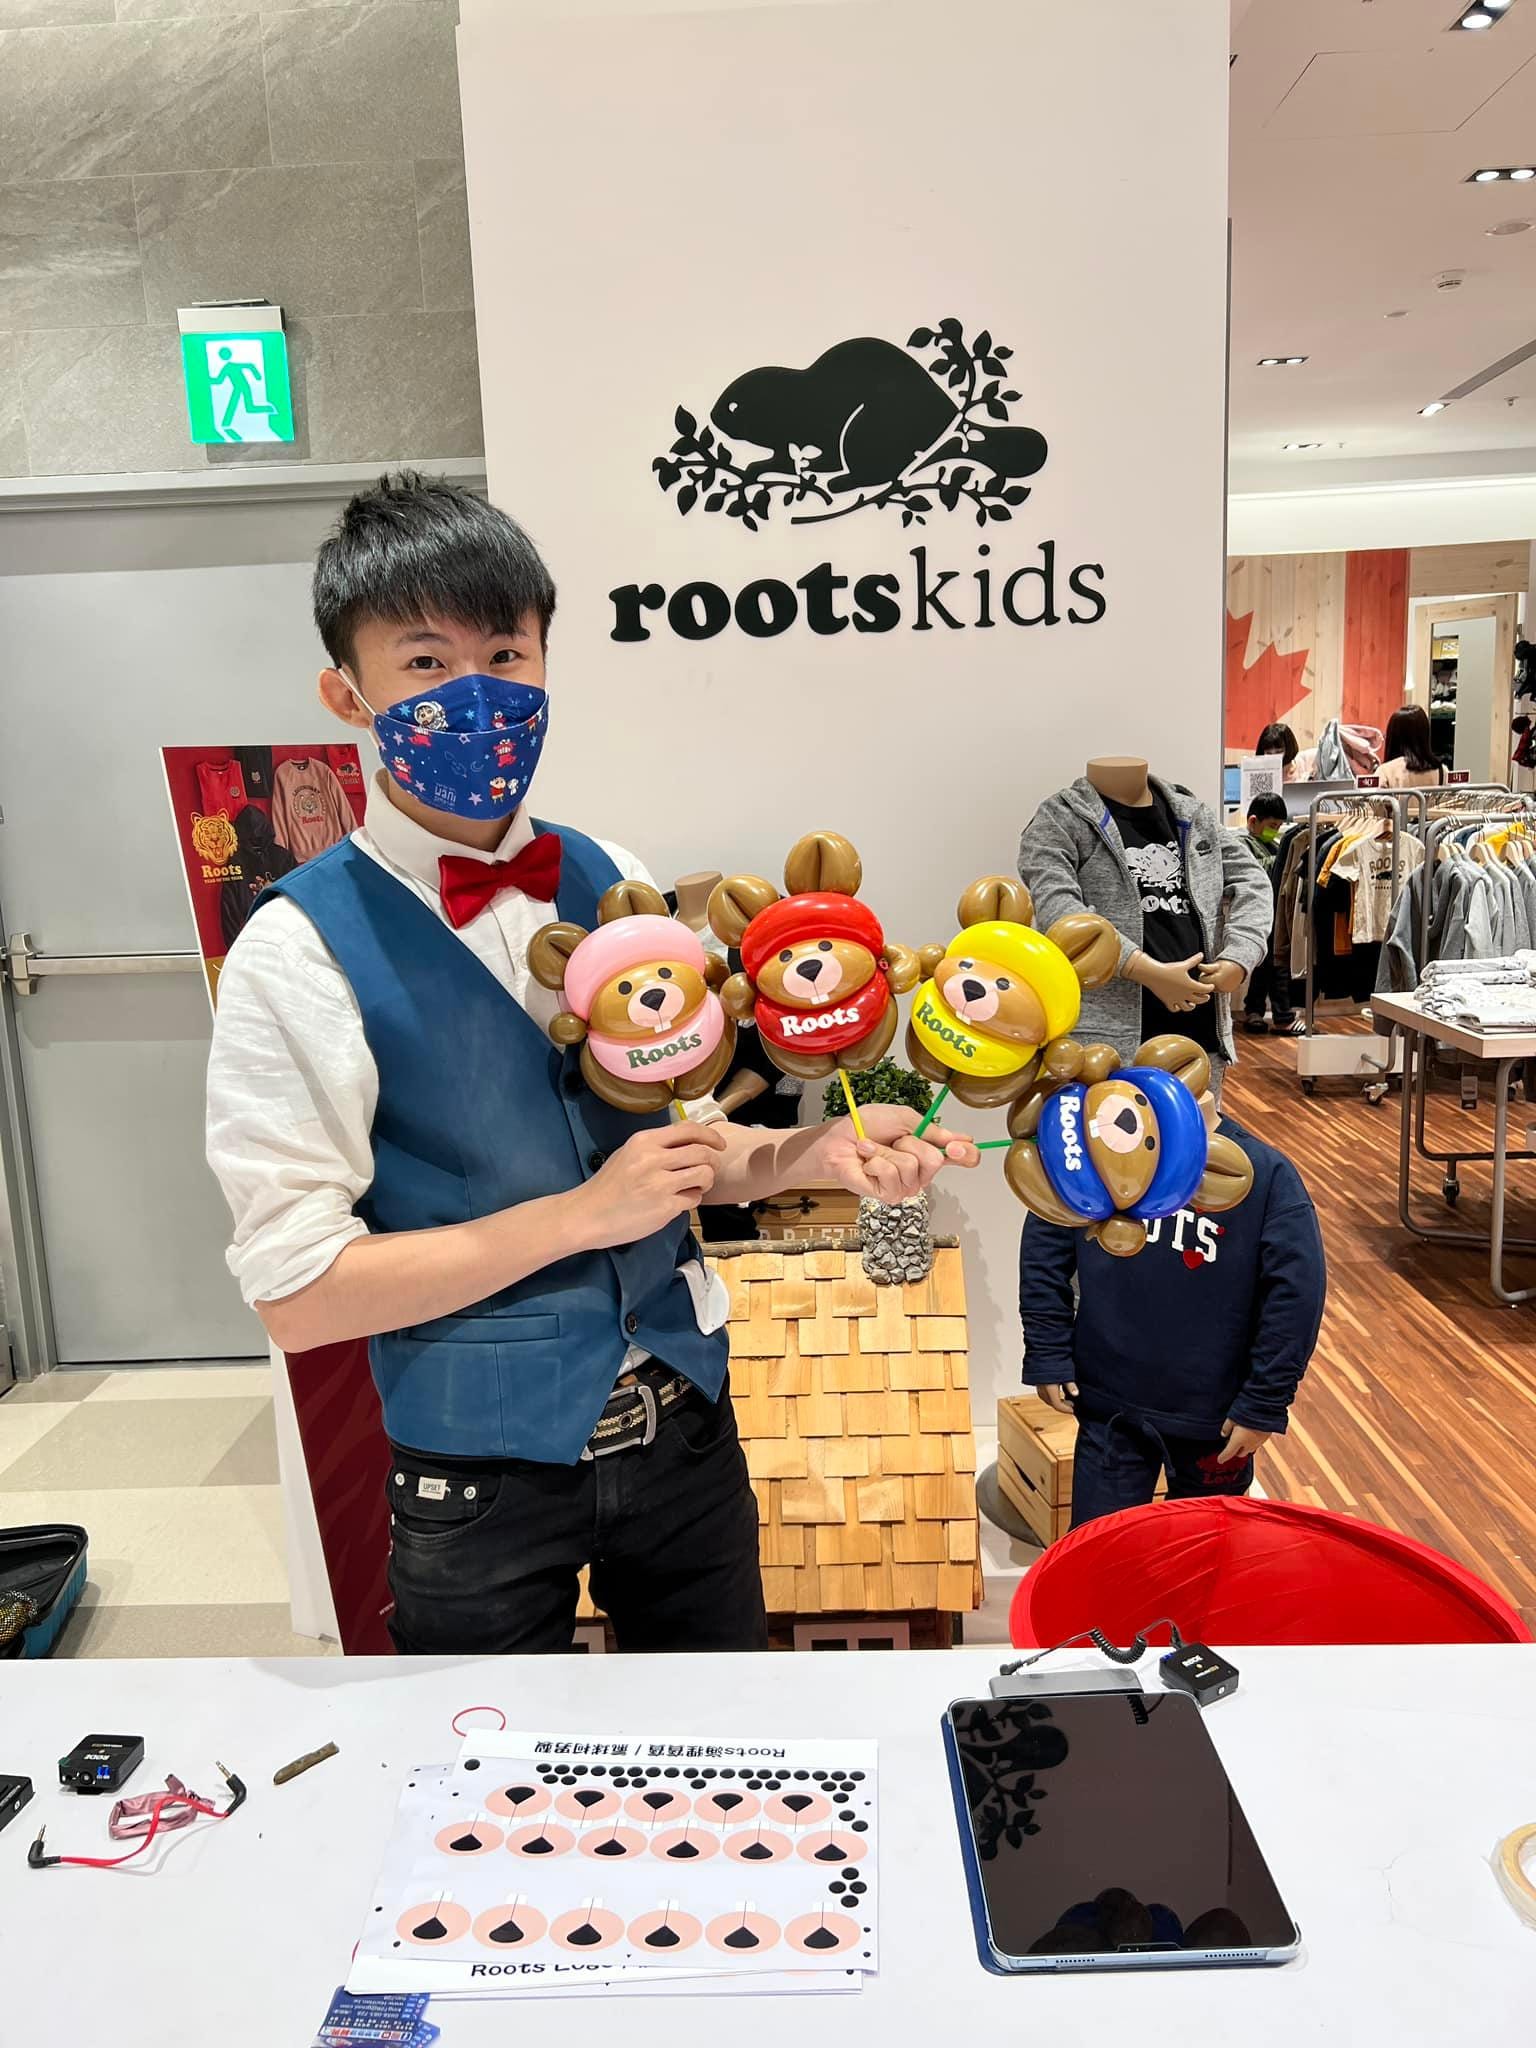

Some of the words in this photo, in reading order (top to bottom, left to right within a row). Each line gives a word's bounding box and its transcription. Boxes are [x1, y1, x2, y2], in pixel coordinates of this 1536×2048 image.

[201, 864, 242, 878] Roots
[1369, 857, 1406, 873] ROOS
[779, 1005, 860, 1037] Roots
[916, 1002, 976, 1058] Roots
[625, 1032, 702, 1069] Roots
[1059, 1095, 1083, 1171] Roots
[1142, 1208, 1219, 1263] OTS
[471, 1963, 546, 1977] Roots
